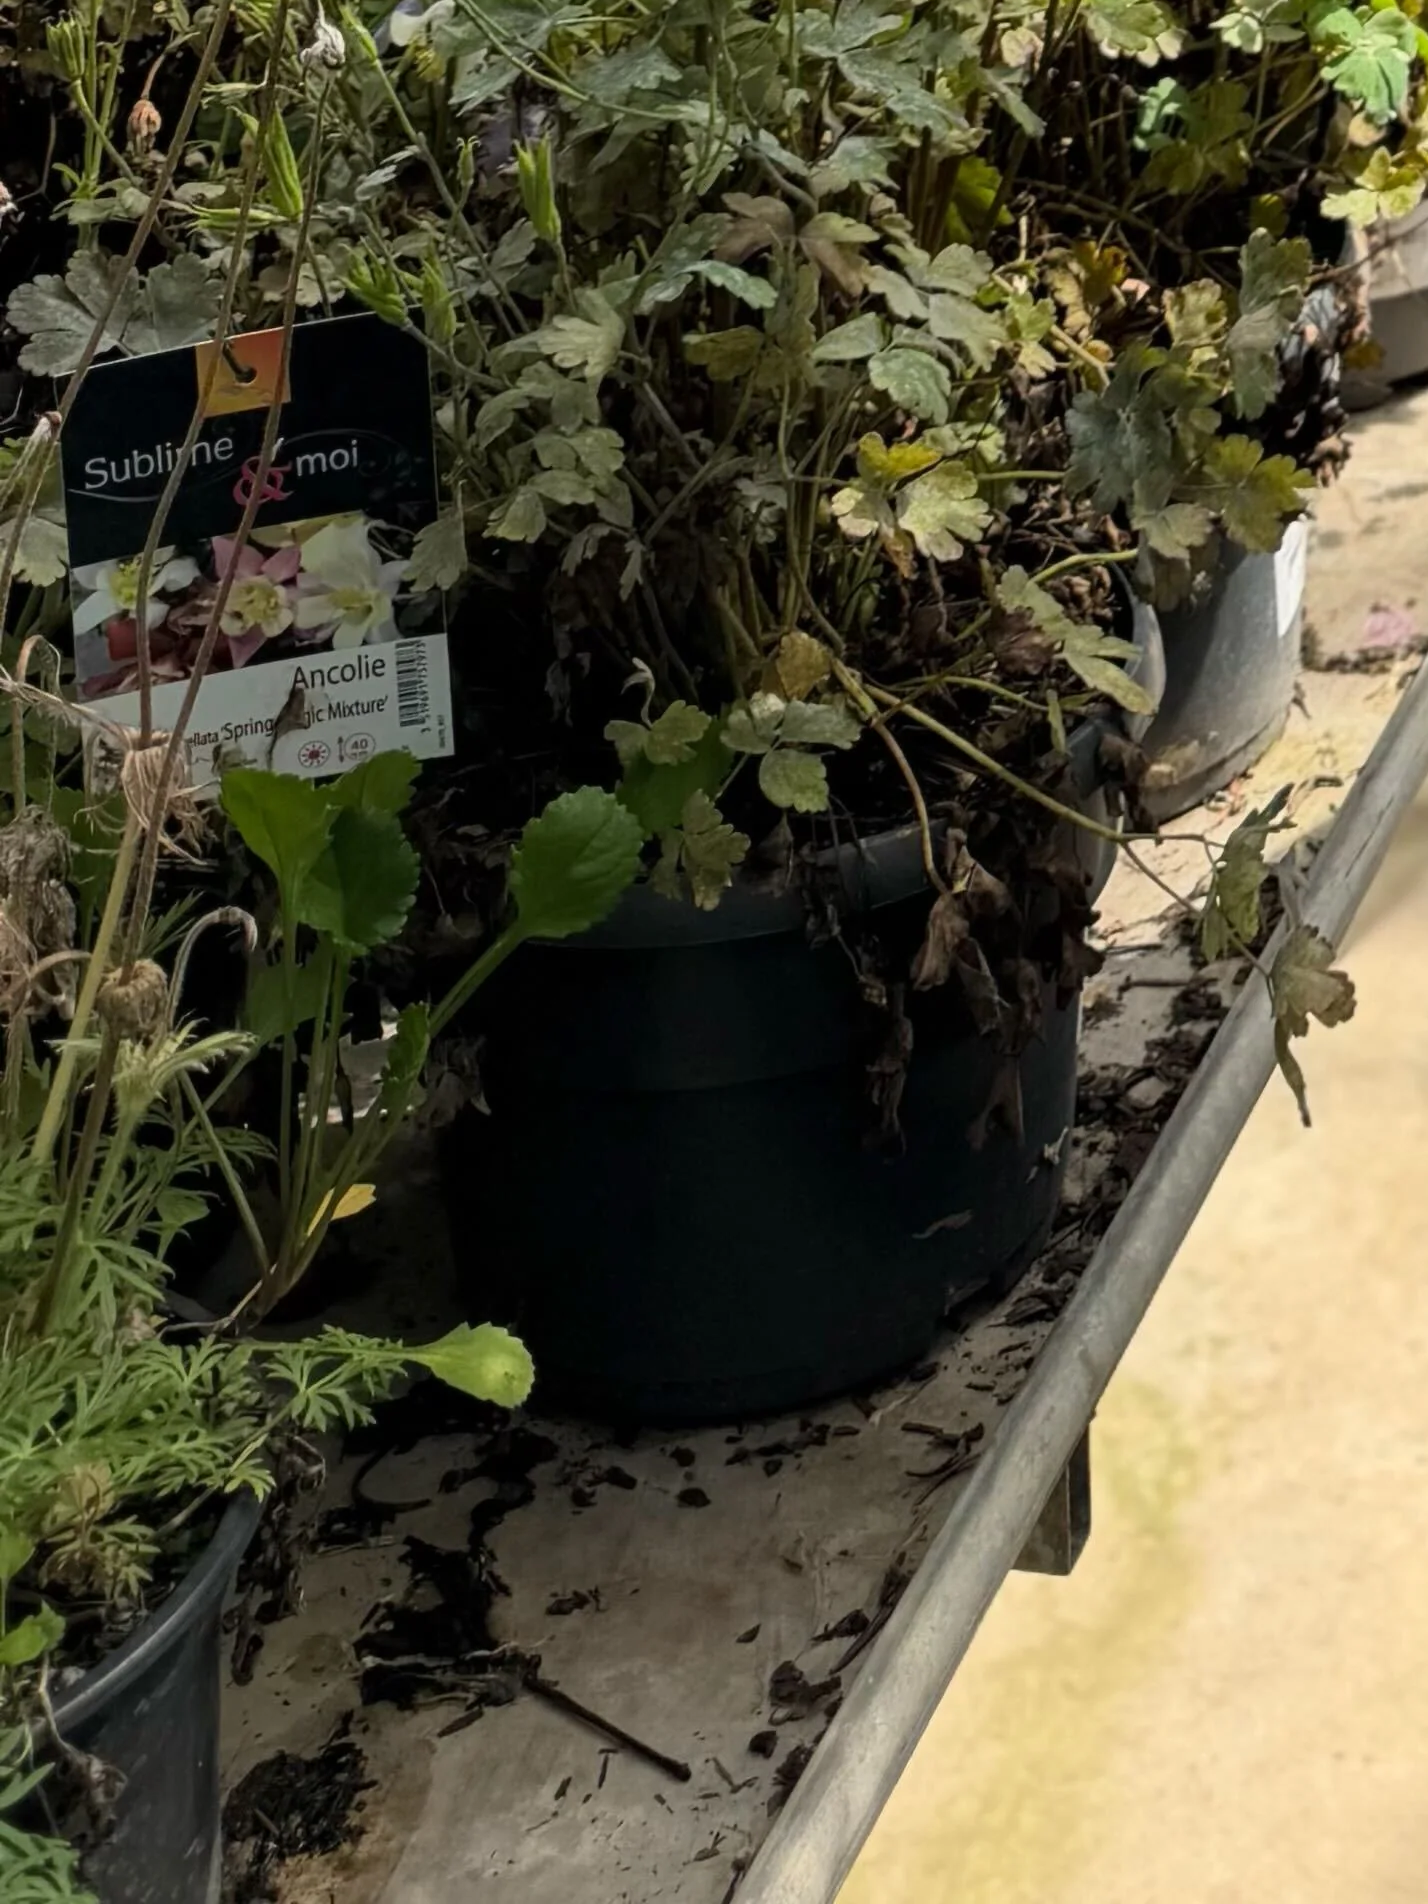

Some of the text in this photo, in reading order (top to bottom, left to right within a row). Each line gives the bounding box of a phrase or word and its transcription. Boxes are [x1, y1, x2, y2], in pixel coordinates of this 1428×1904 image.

[85, 436, 233, 490] Sublime
[296, 439, 359, 476] moi
[292, 654, 386, 690] Ancolie
